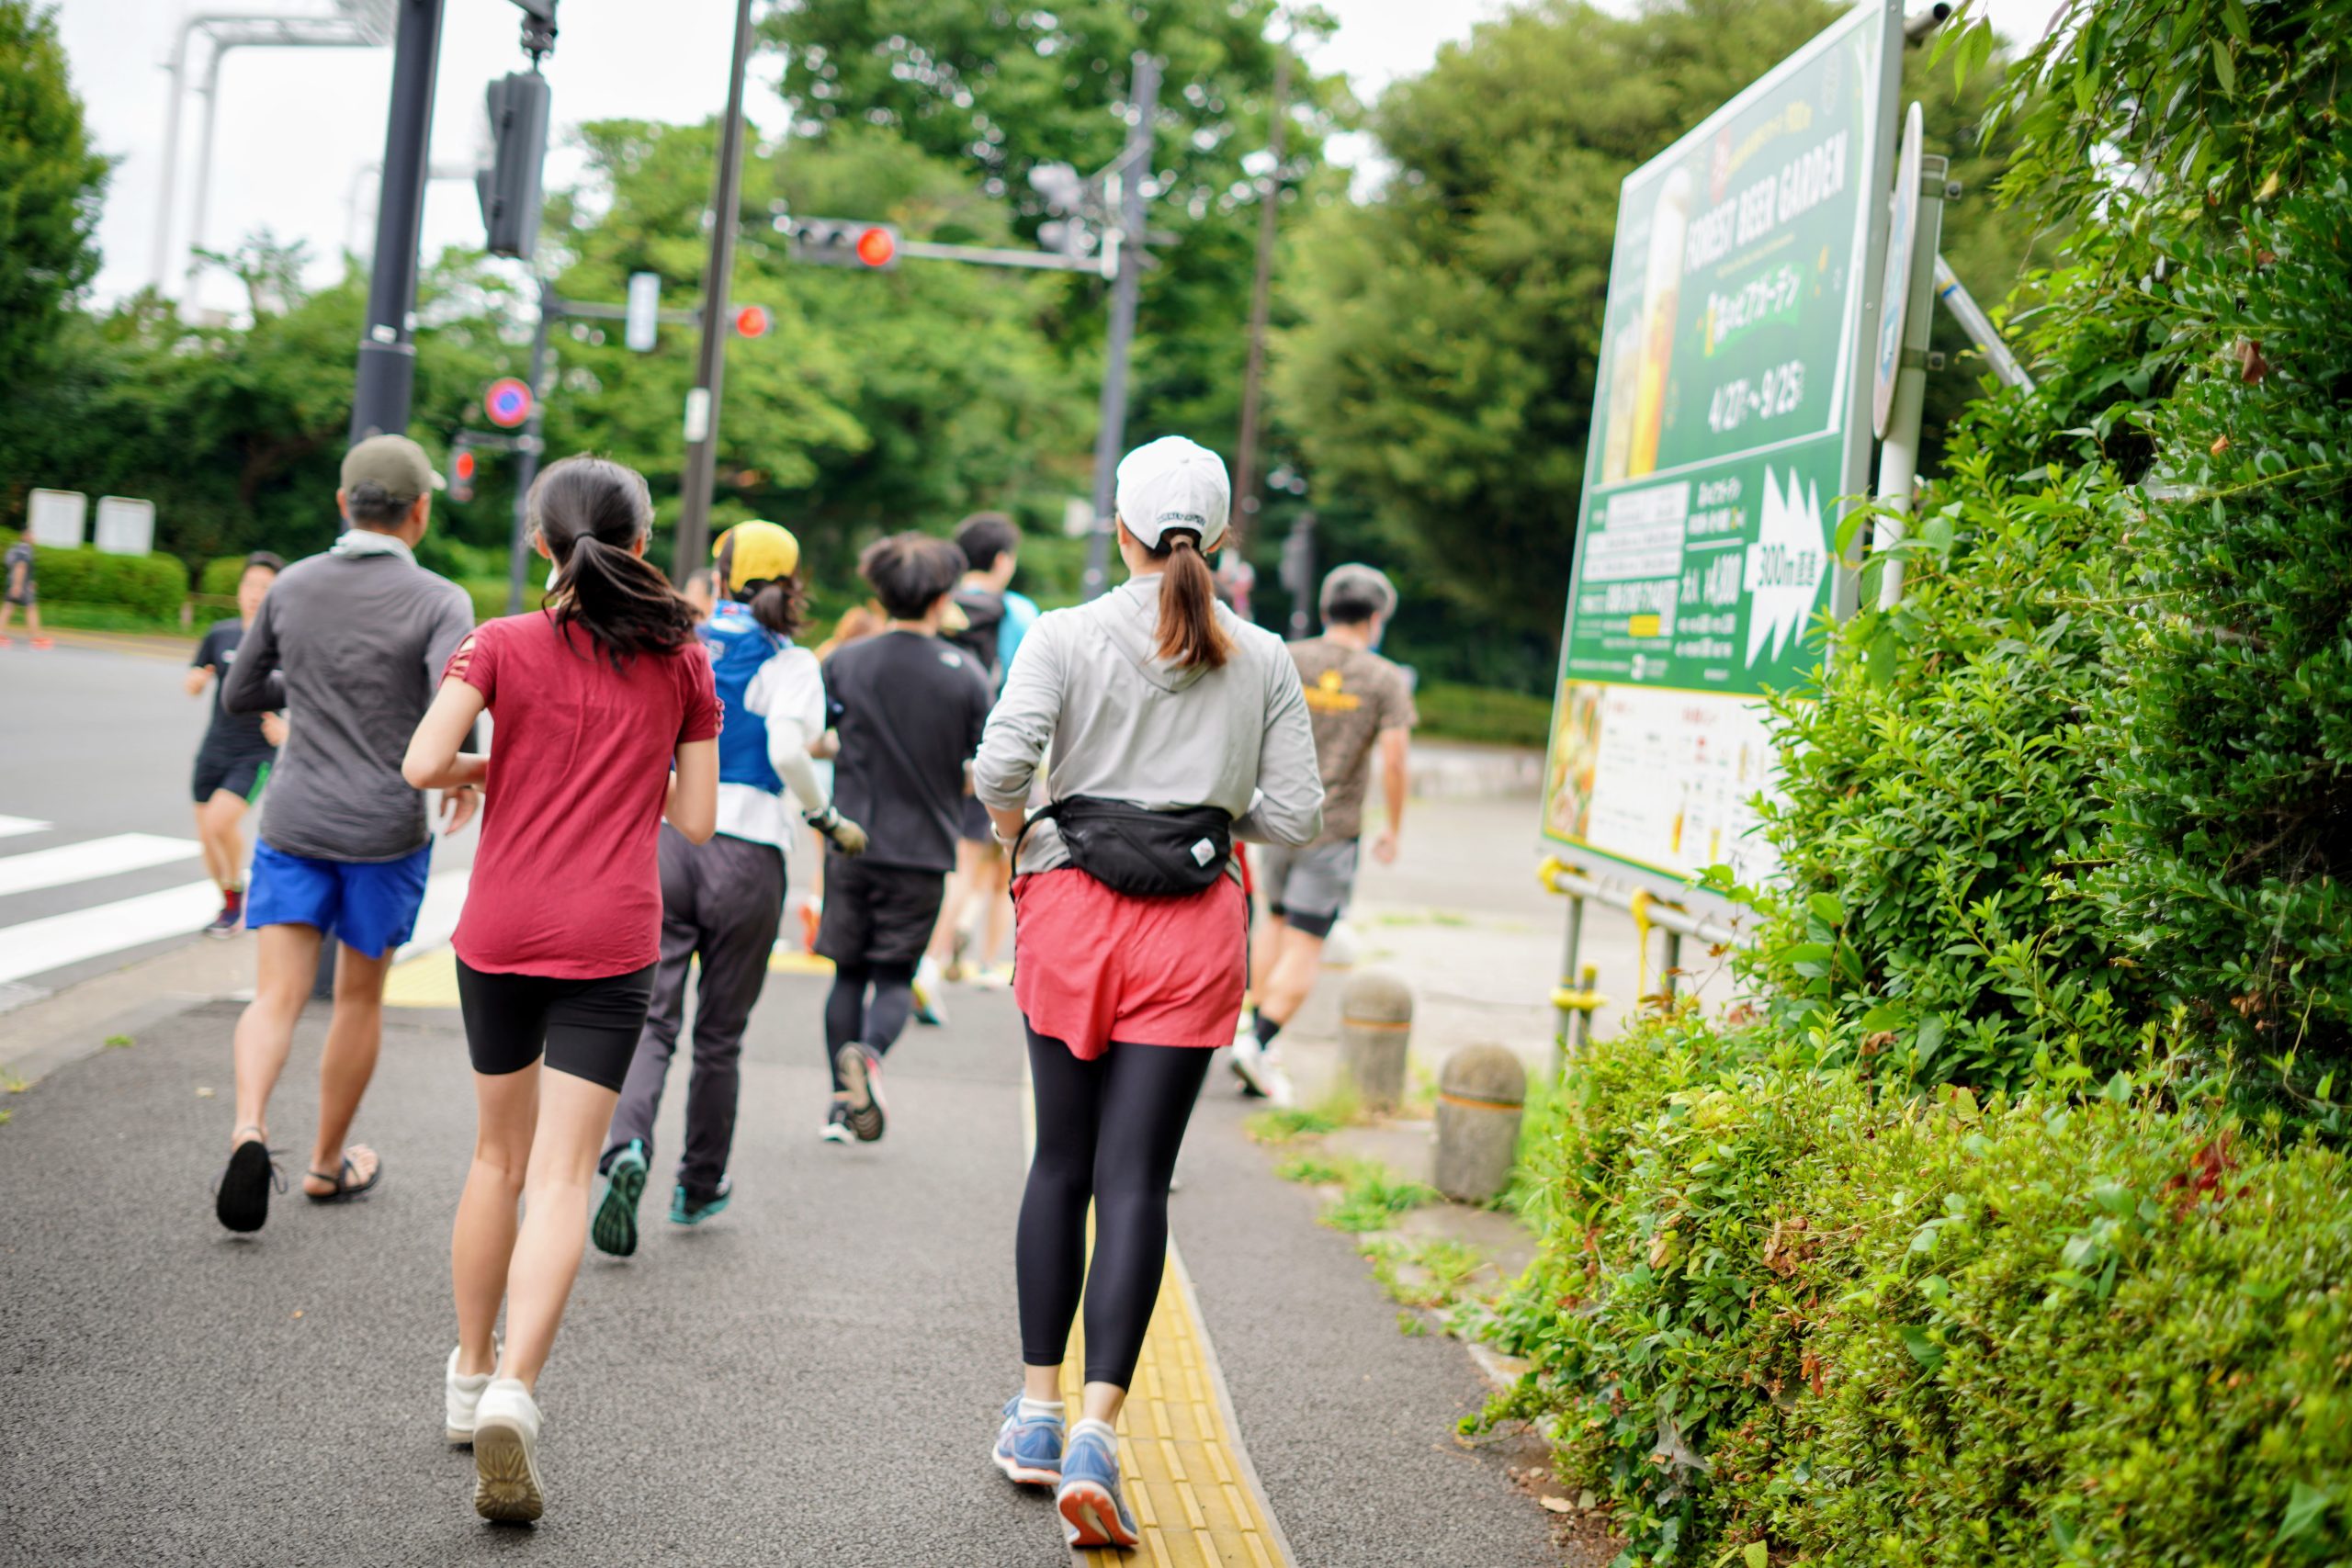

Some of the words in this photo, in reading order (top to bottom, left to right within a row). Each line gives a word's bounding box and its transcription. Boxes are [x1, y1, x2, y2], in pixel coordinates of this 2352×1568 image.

[1685, 197, 1736, 274] FOREST
[1736, 174, 1777, 247] BEER
[1778, 129, 1848, 223] GARDEN
